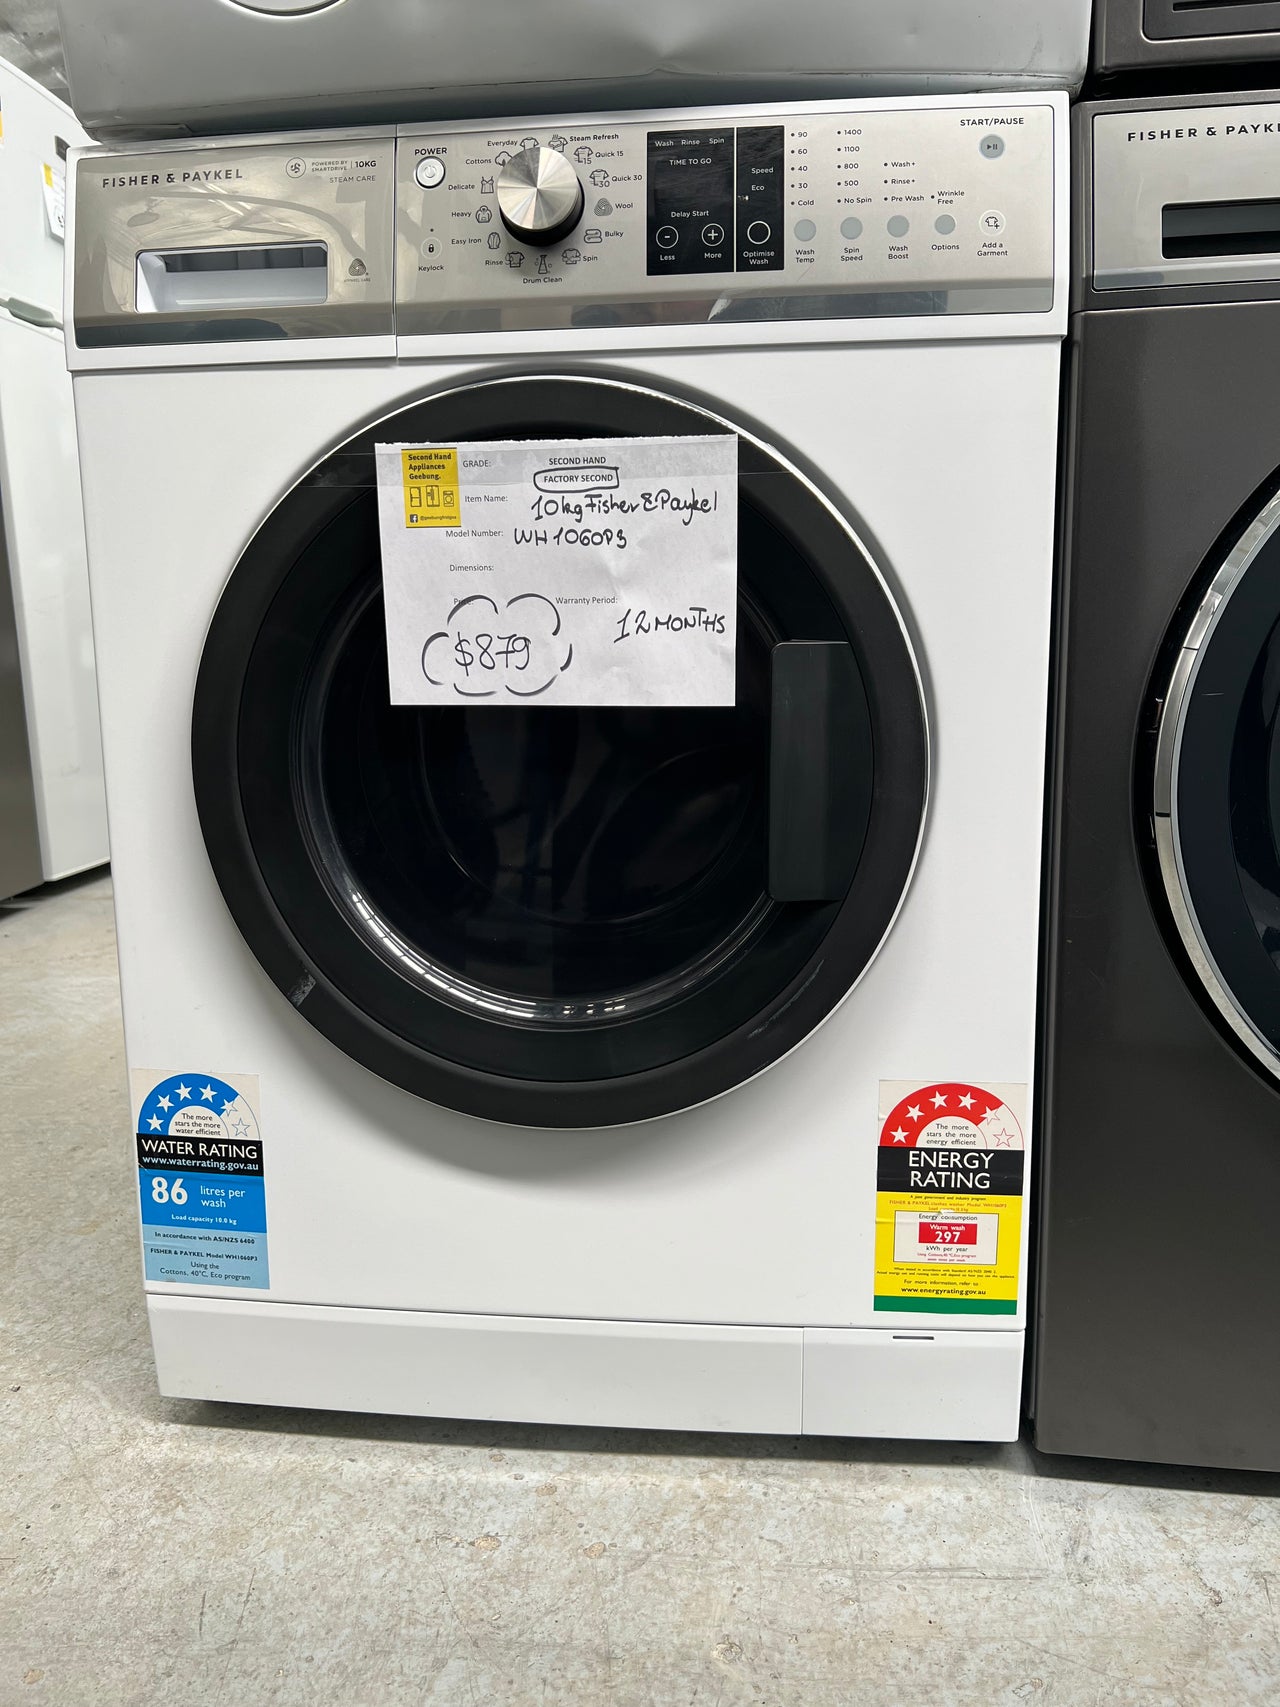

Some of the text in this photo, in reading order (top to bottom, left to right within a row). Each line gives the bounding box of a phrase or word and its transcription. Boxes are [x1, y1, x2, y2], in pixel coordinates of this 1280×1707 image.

[960, 117, 1024, 127] START/PAUSE
[569, 133, 619, 142] Steam Refresh
[1127, 127, 1198, 142] FISHER
[1206, 126, 1217, 136] &
[487, 139, 518, 148] Everyday
[681, 138, 700, 146] Rinse
[709, 137, 725, 145] Spin
[414, 147, 448, 156] POWER
[595, 151, 612, 159] Quick
[354, 160, 377, 168] 10KG
[465, 157, 492, 165] Cottons
[700, 157, 712, 165] GO
[751, 167, 774, 175] Speed
[102, 168, 243, 188] FISHER & PAYKEL
[329, 176, 354, 184] STEAM
[448, 183, 475, 191] Delicate
[937, 189, 965, 197] Wrinkle
[857, 196, 872, 205] Spin
[903, 194, 925, 202] Wash
[797, 199, 815, 207] Cold
[451, 211, 472, 219] Heavy
[670, 211, 691, 219] Delay
[604, 230, 624, 238] Bulky
[843, 247, 860, 255] Spin
[931, 243, 960, 251] Options
[743, 250, 775, 258] Optimise
[795, 248, 815, 256] Wash
[977, 249, 1008, 257] Garment
[582, 254, 598, 263] Spin
[795, 256, 815, 264] Temp
[840, 254, 863, 263] Speed
[418, 264, 444, 272] Keylock
[462, 460, 491, 468] GRADE:
[548, 456, 606, 466] SECOND HAND
[408, 463, 445, 471] Appliances
[543, 473, 613, 484] FACTORY SECOND
[531, 495, 583, 523] 10kg
[584, 493, 639, 514] Fisher
[654, 487, 717, 526] Paykel
[446, 530, 470, 538] Model
[449, 563, 495, 572] Dimensions:
[555, 596, 618, 605] Warranty Period:
[613, 606, 725, 643] 12 MONTHS
[454, 631, 531, 677] $879
[195, 1128, 221, 1136] efficient
[142, 1139, 257, 1159] WATER RATING
[142, 1156, 259, 1171] www.waterrating.gov.au
[908, 1150, 994, 1169] ENERGY
[910, 1170, 990, 1189] RATING
[151, 1176, 188, 1205] 86
[200, 1186, 245, 1199] litres per
[200, 1198, 226, 1208] wash
[188, 1214, 213, 1223] capacity
[215, 1216, 228, 1224] 10.0
[229, 1218, 237, 1226] kg
[918, 1213, 938, 1221] Energy
[929, 1223, 948, 1231] Warm
[162, 1232, 197, 1240] accordance
[934, 1230, 961, 1243] 297
[179, 1250, 204, 1258] PAYKEL
[190, 1261, 208, 1270] Using
[224, 1273, 251, 1281] program
[901, 1287, 987, 1296] www.energyrating.gov.au
